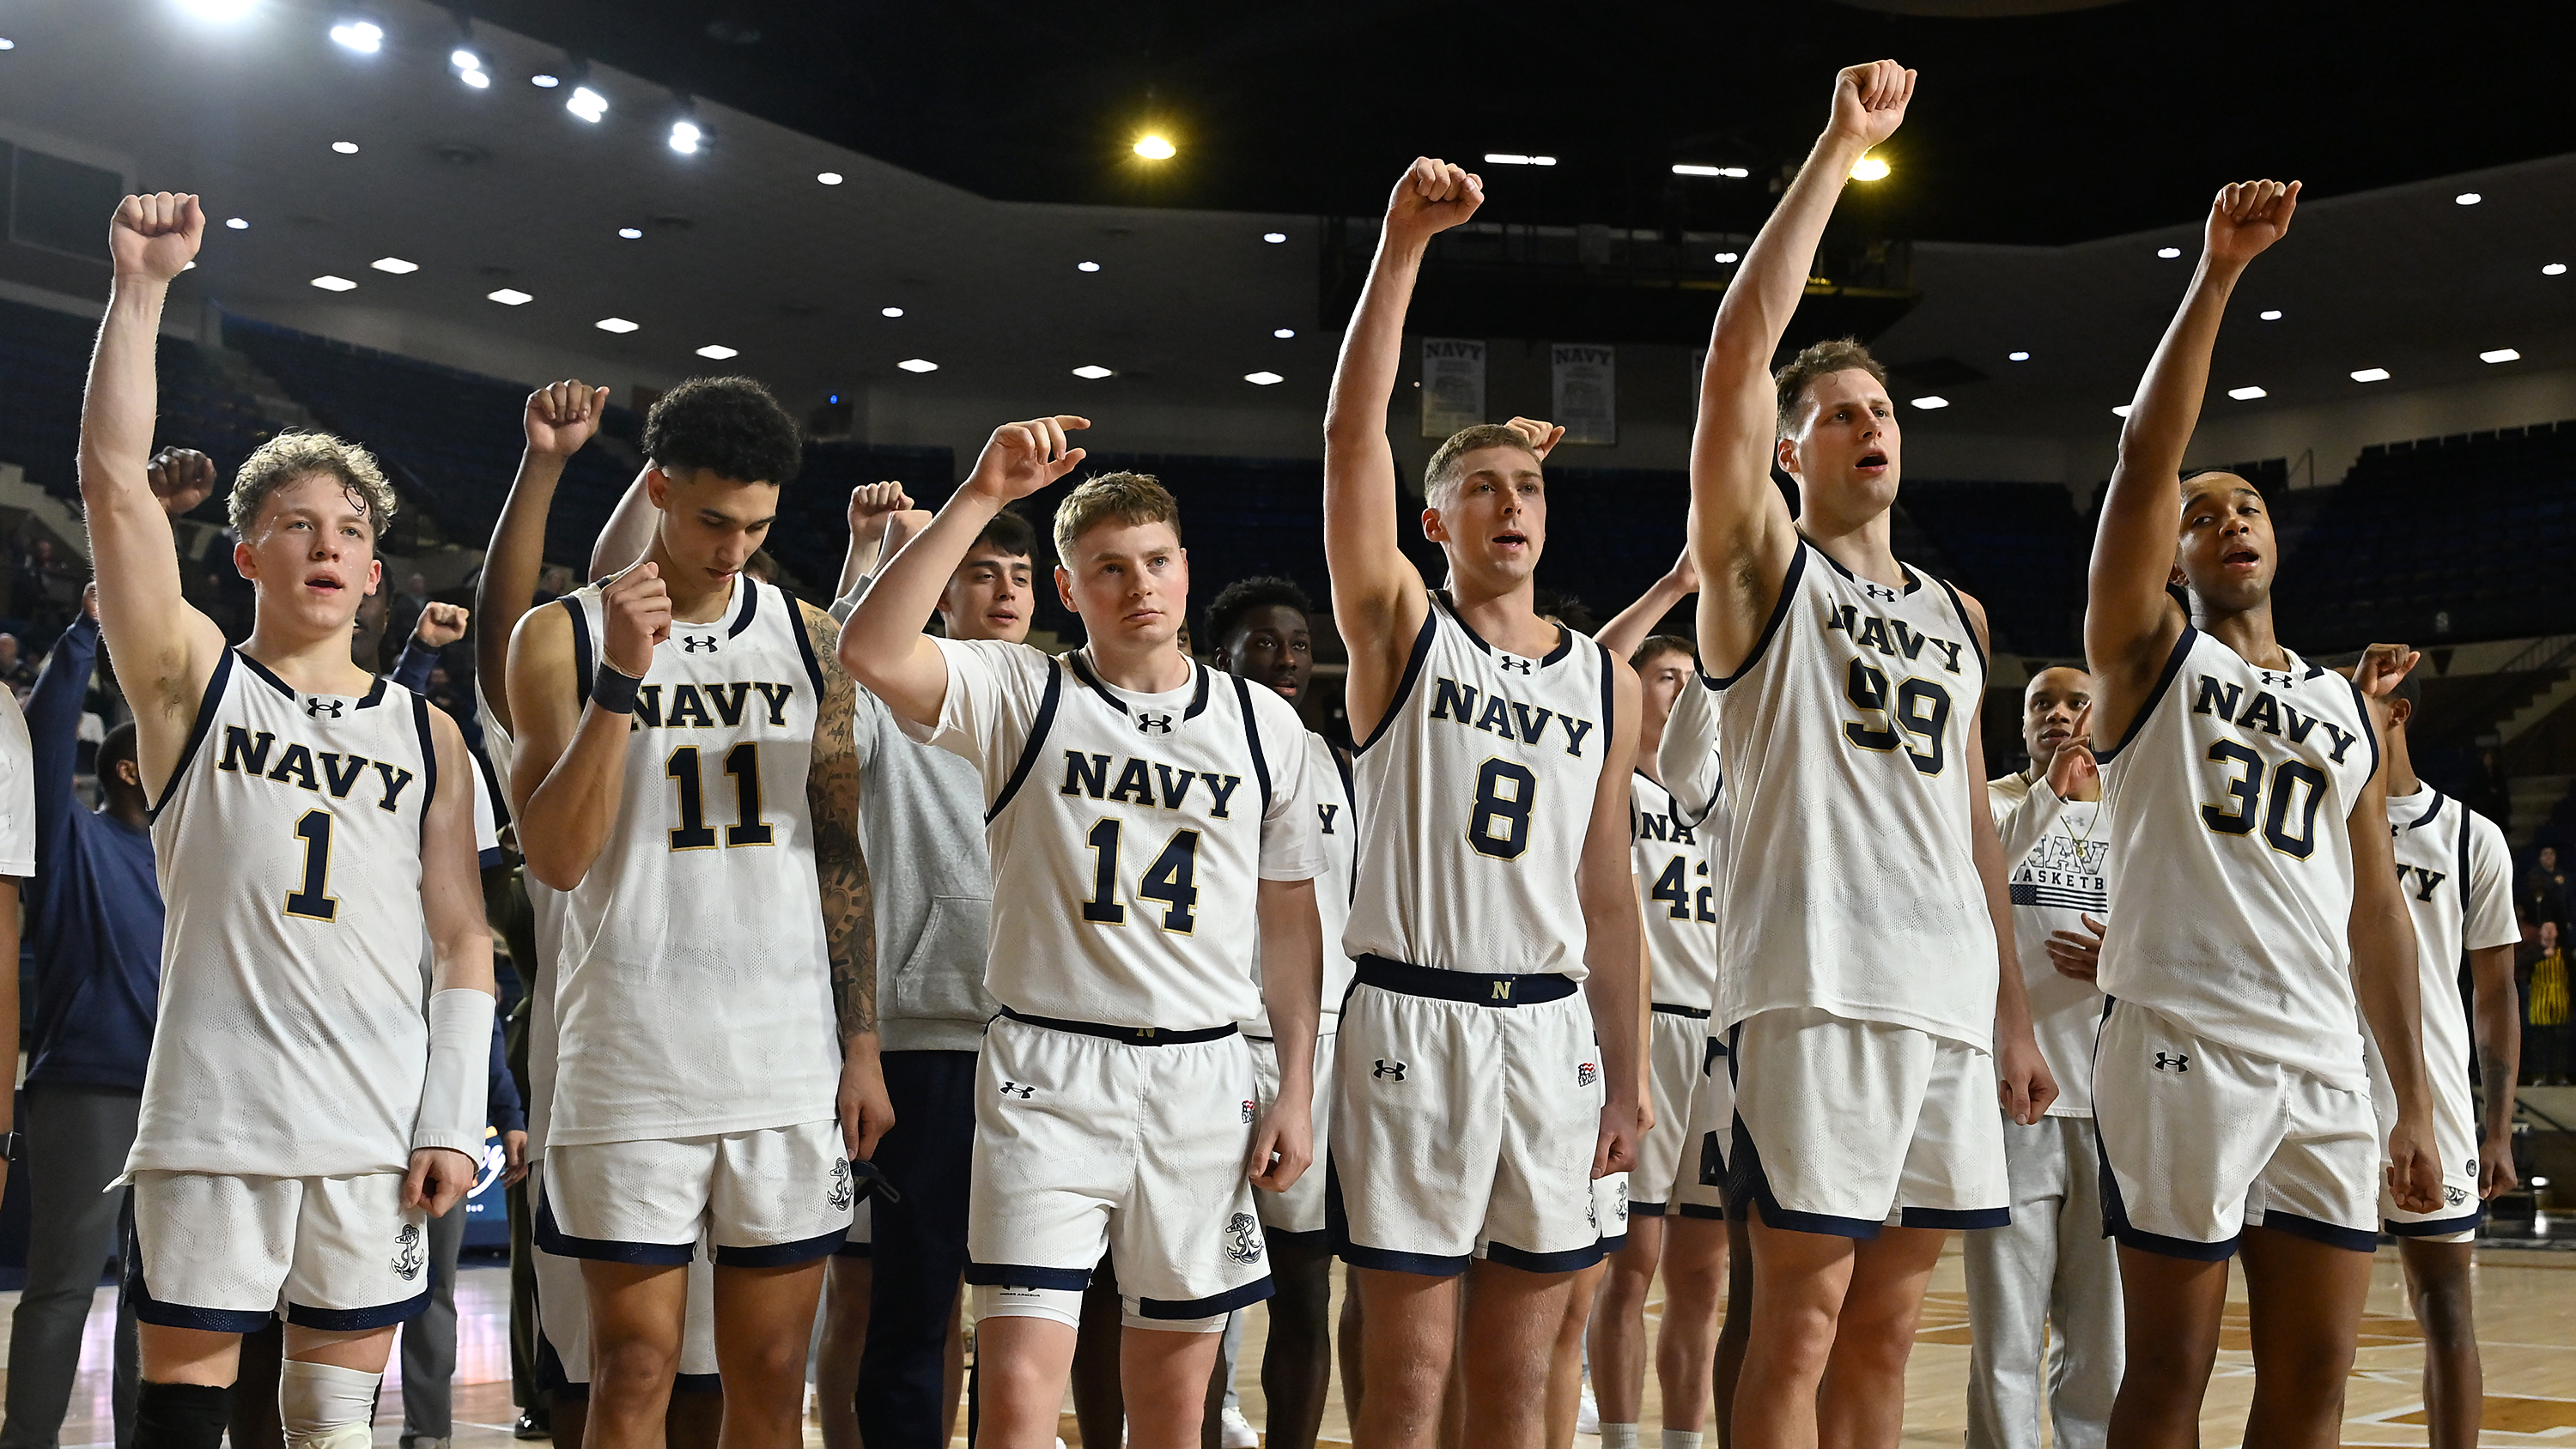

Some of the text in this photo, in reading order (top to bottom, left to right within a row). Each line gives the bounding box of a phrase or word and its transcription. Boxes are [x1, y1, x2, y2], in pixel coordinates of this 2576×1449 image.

[1426, 344, 1482, 360] NAVY
[1555, 349, 1610, 365] NAVY
[1828, 591, 1962, 676] NAVY
[630, 682, 794, 731] NAVY
[1429, 677, 1594, 760] NAVY
[1842, 655, 1952, 778] 99
[2192, 674, 2358, 766] NAVY
[216, 724, 415, 815] NAVY
[665, 741, 775, 852] 11
[1060, 749, 1241, 820] NAVY
[1466, 755, 1538, 861] 8
[2200, 737, 2329, 862] 30
[283, 808, 338, 923] 1
[1639, 811, 1697, 846] NA
[1082, 816, 1203, 934] 14
[1650, 853, 1716, 925] 42
[1491, 980, 1512, 1000] N
[399, 1234, 416, 1242] NAVY
[1230, 1218, 1250, 1231] NAVY
